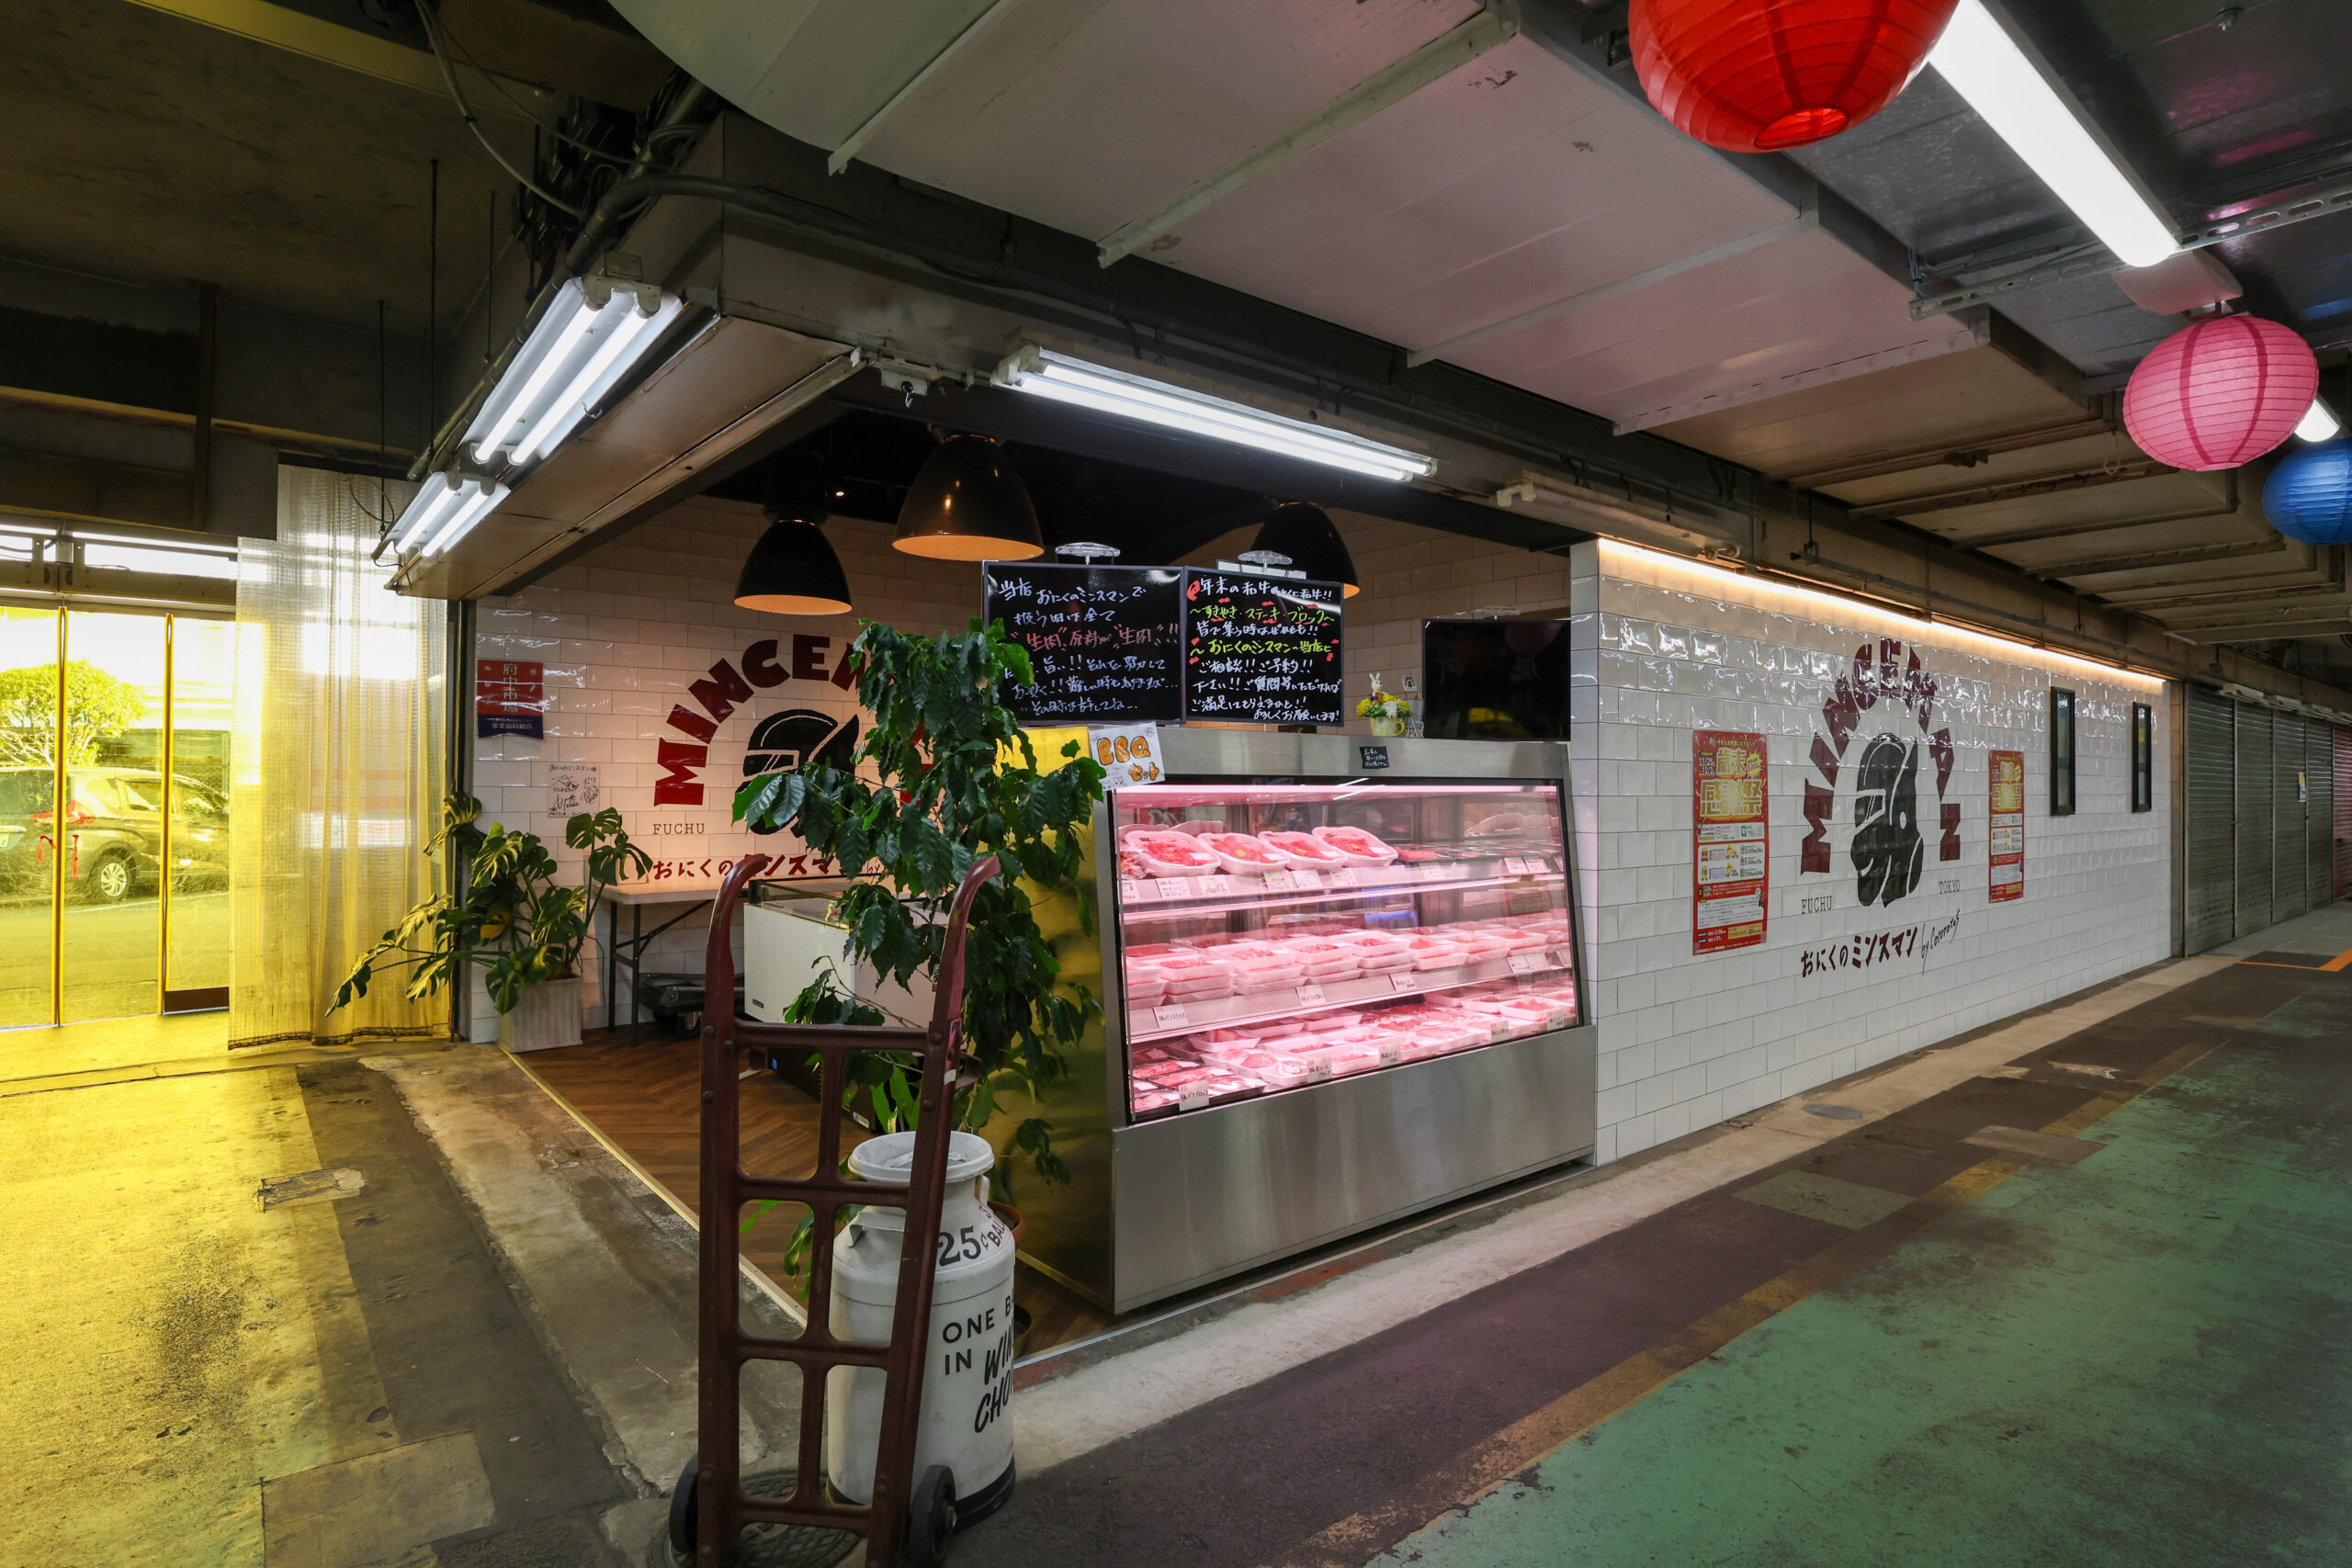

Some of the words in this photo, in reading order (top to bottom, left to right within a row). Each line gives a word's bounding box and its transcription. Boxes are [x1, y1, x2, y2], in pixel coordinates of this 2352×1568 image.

[1097, 735, 1151, 766] BBQ
[652, 823, 706, 835] FUCHU
[1939, 879, 1961, 894] TOKYO
[1802, 896, 1833, 915] FUCHU
[1801, 926, 1918, 978] おにくのミンスマン
[943, 1308, 995, 1343] ONE
[944, 1348, 972, 1375] IN
